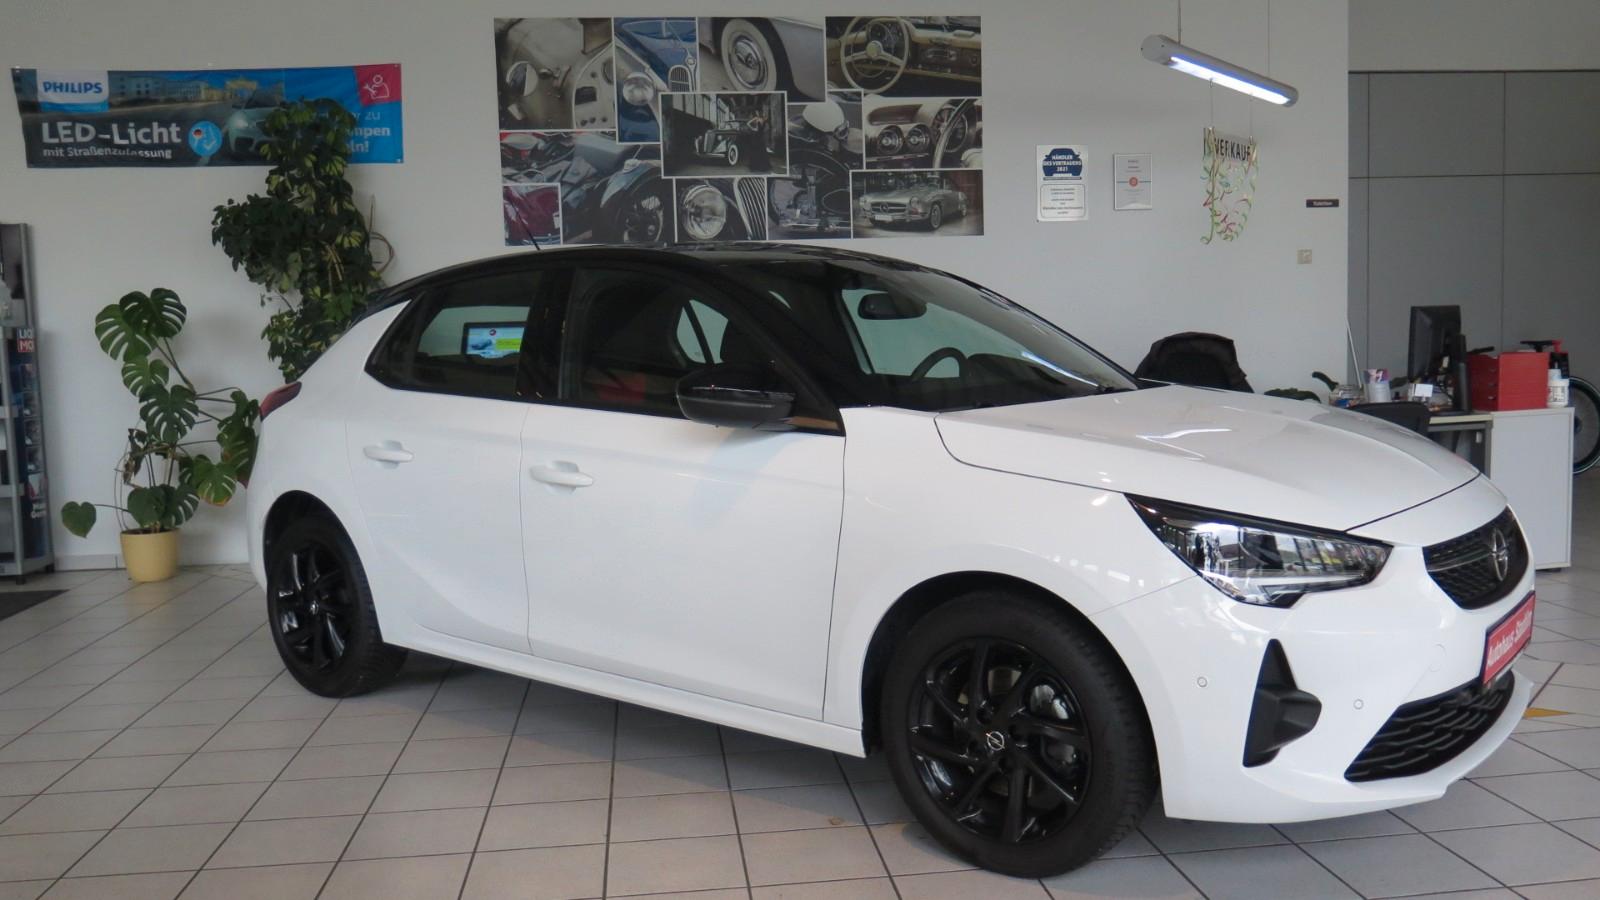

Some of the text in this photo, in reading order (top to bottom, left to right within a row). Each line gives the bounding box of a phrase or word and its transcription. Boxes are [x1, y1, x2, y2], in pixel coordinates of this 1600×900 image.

[42, 81, 103, 94] PHILIPS
[42, 121, 182, 145] LED-Licht
[42, 146, 173, 160] mit Straßenzulassung
